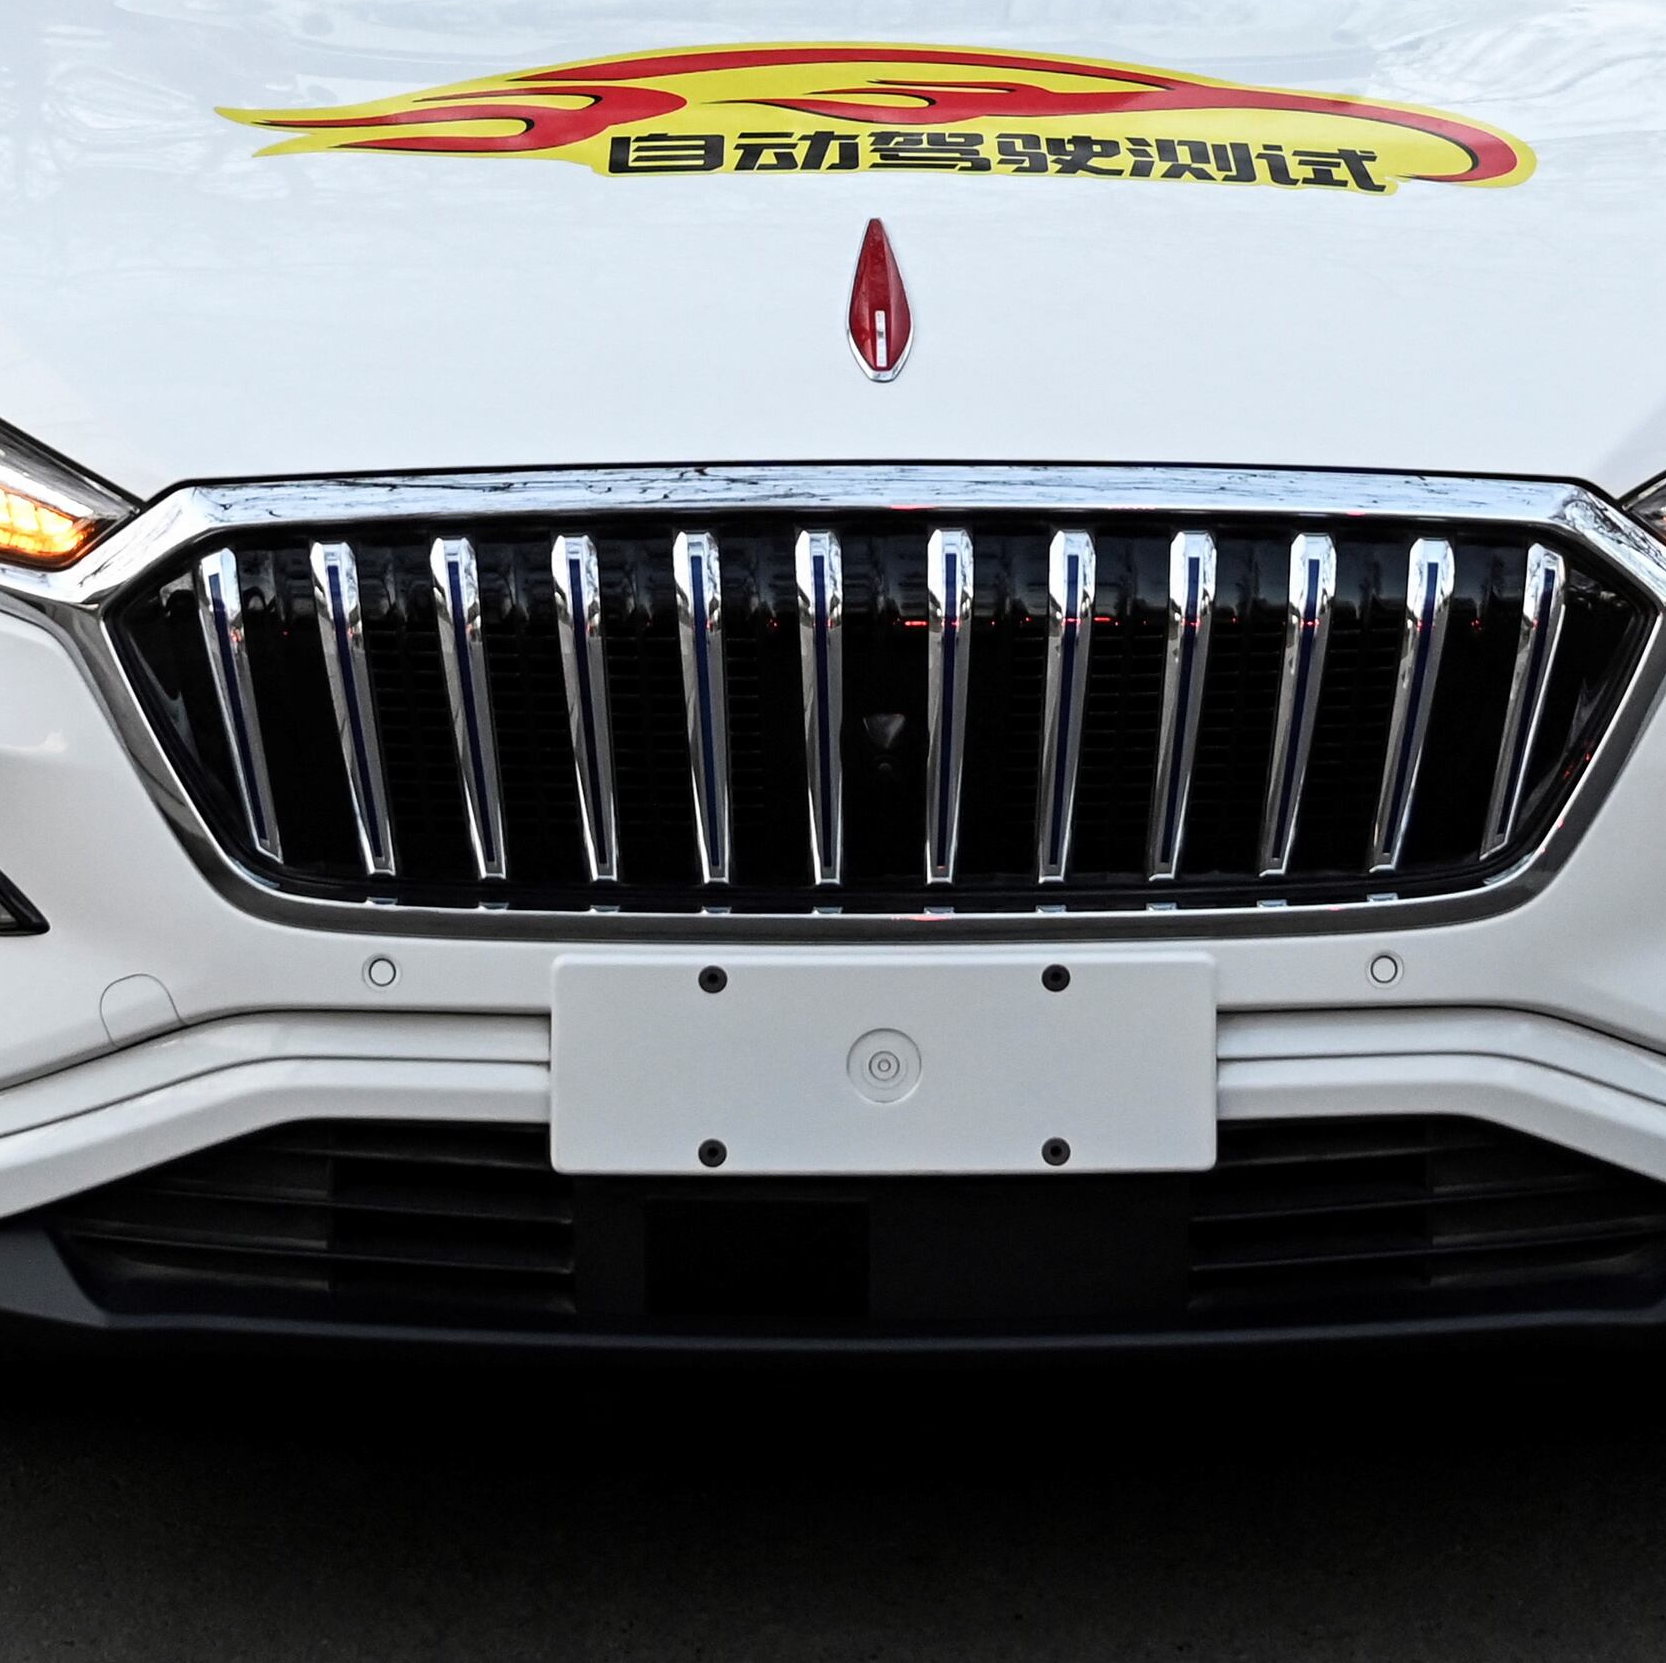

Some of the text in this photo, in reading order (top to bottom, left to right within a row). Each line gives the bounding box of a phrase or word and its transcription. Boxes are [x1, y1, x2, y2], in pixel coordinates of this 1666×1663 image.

[608, 131, 1386, 192] 自动驾驶测试
